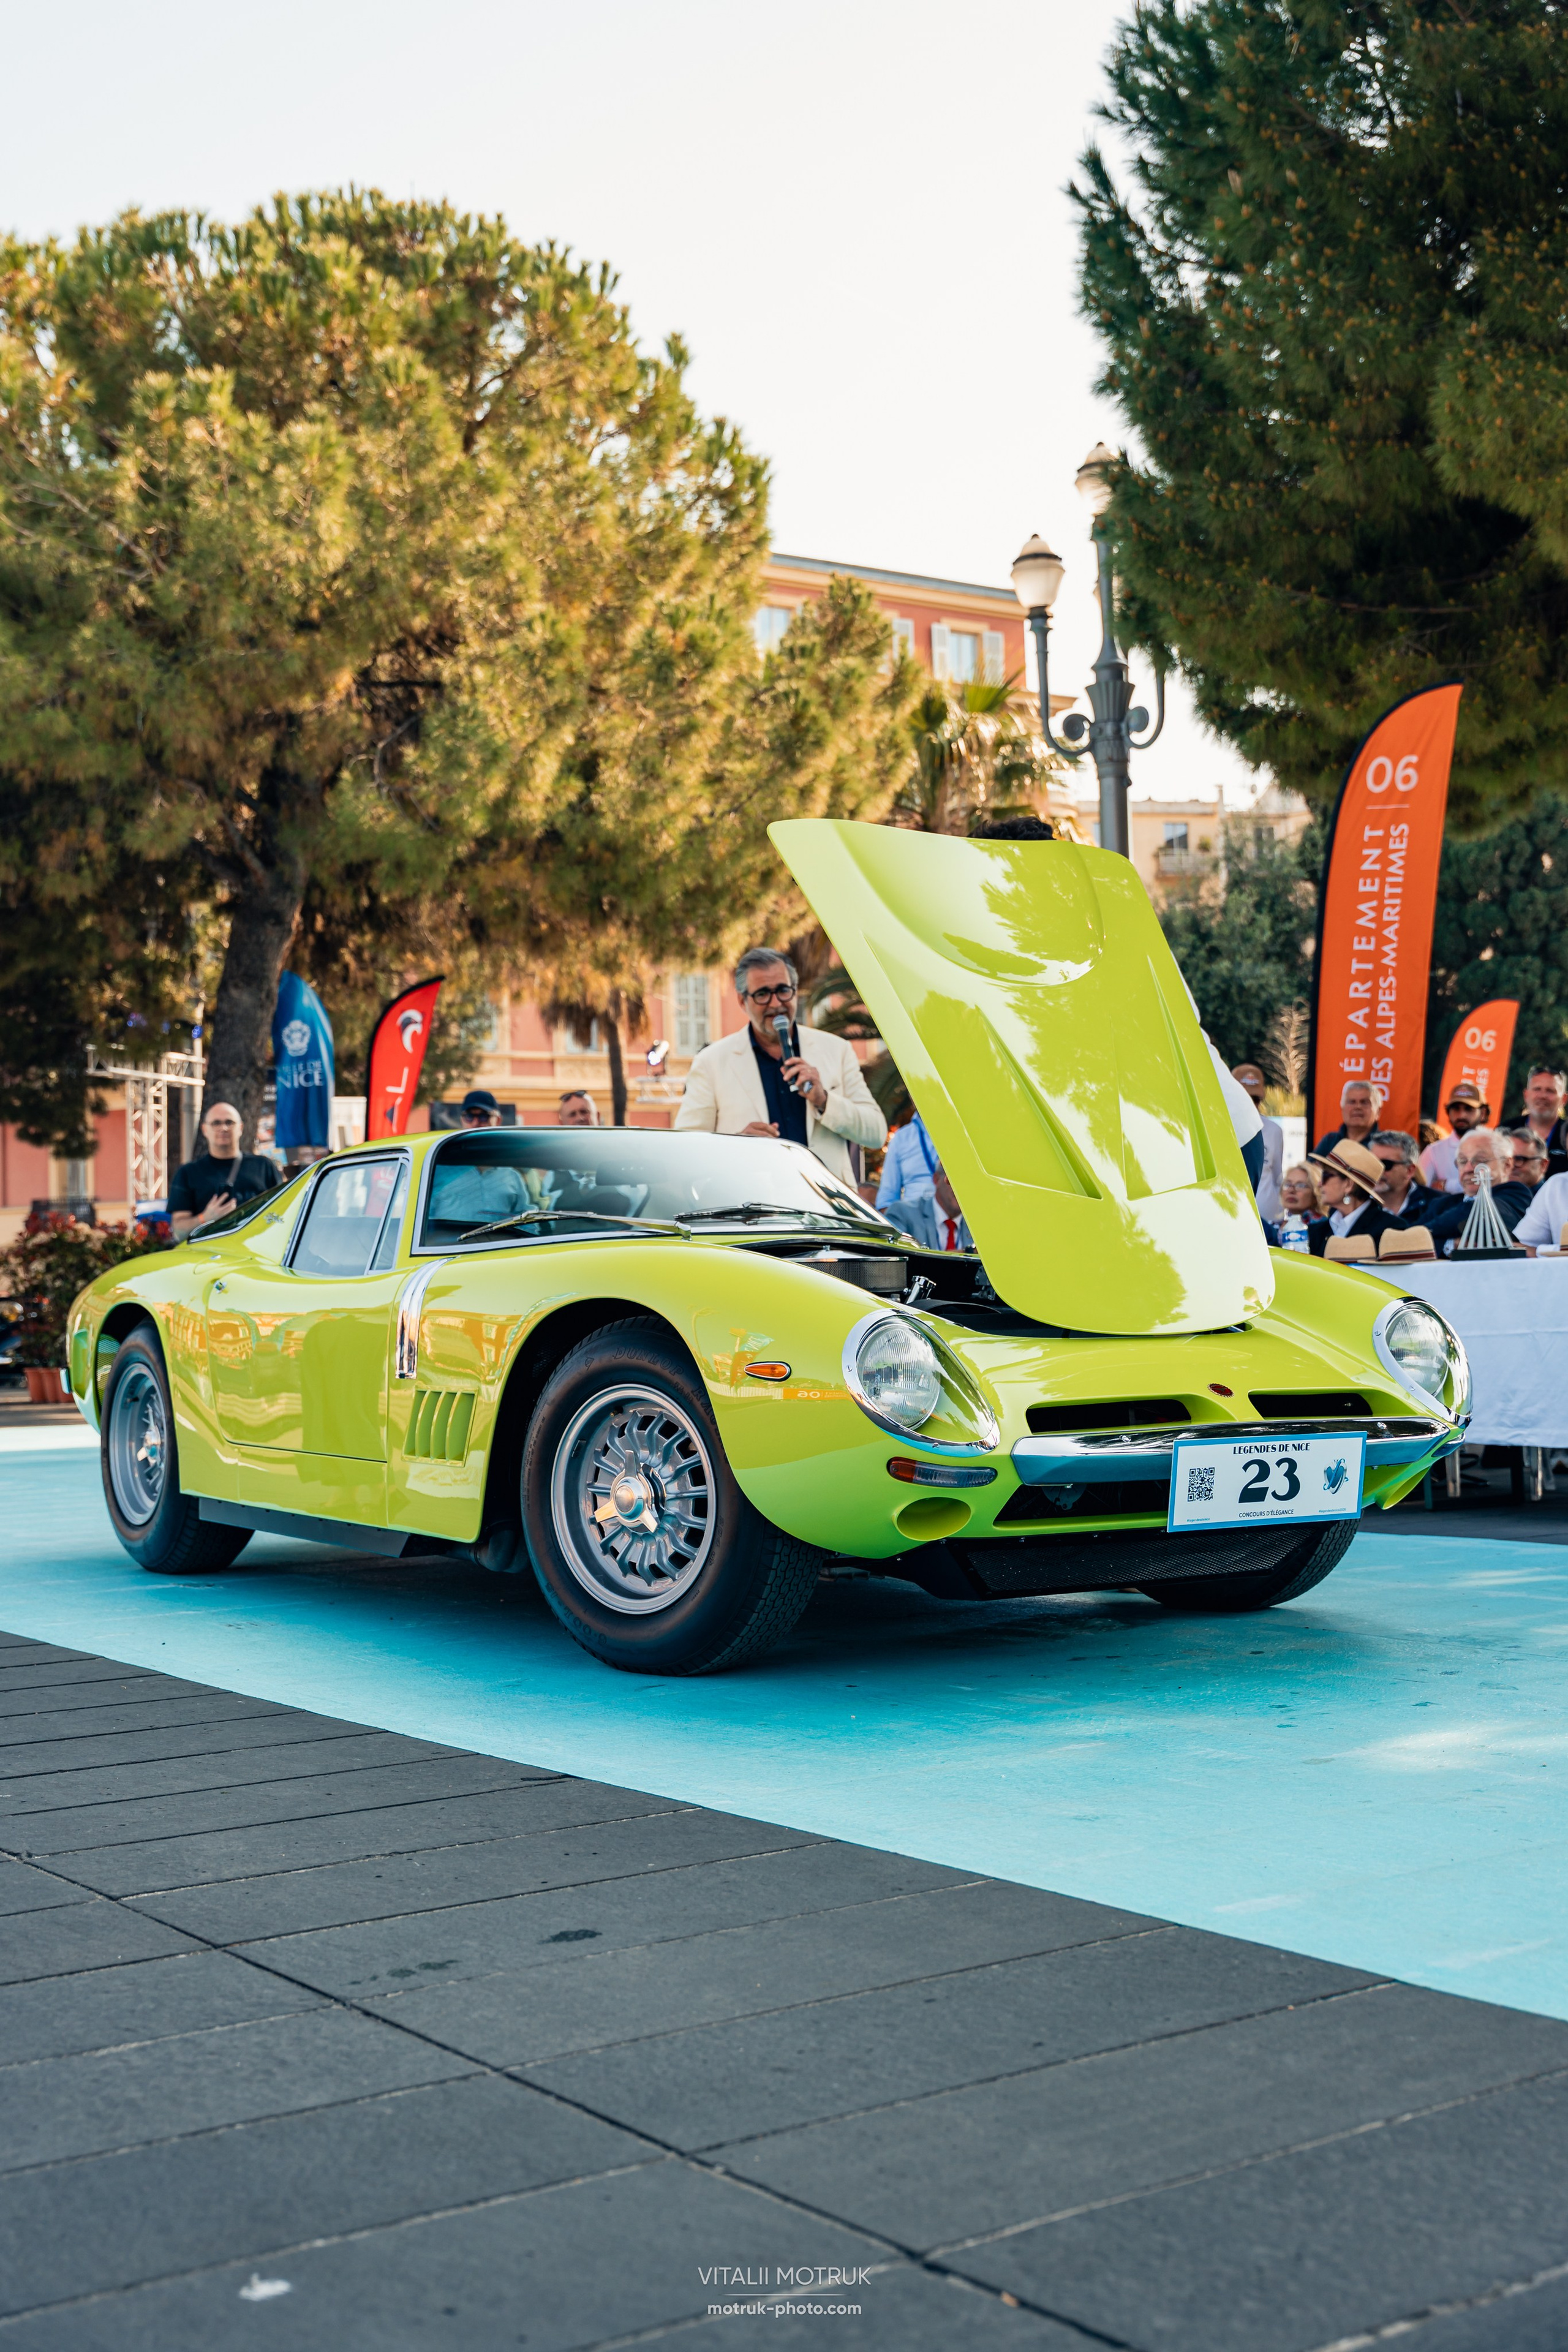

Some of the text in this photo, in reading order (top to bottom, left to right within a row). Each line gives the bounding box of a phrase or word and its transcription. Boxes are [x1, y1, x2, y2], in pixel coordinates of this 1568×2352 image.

[1366, 755, 1419, 793] 06
[1376, 823, 1409, 1049] ALPES-MARITIMES
[1340, 825, 1385, 1088] ÉPARTEMENT
[1464, 1027, 1497, 1052] 06
[277, 1069, 323, 1088] NICE
[612, 1347, 684, 1376] DUNLOP
[1233, 1442, 1310, 1455] LEGENDES DE NICE
[1238, 1457, 1300, 1503] 23
